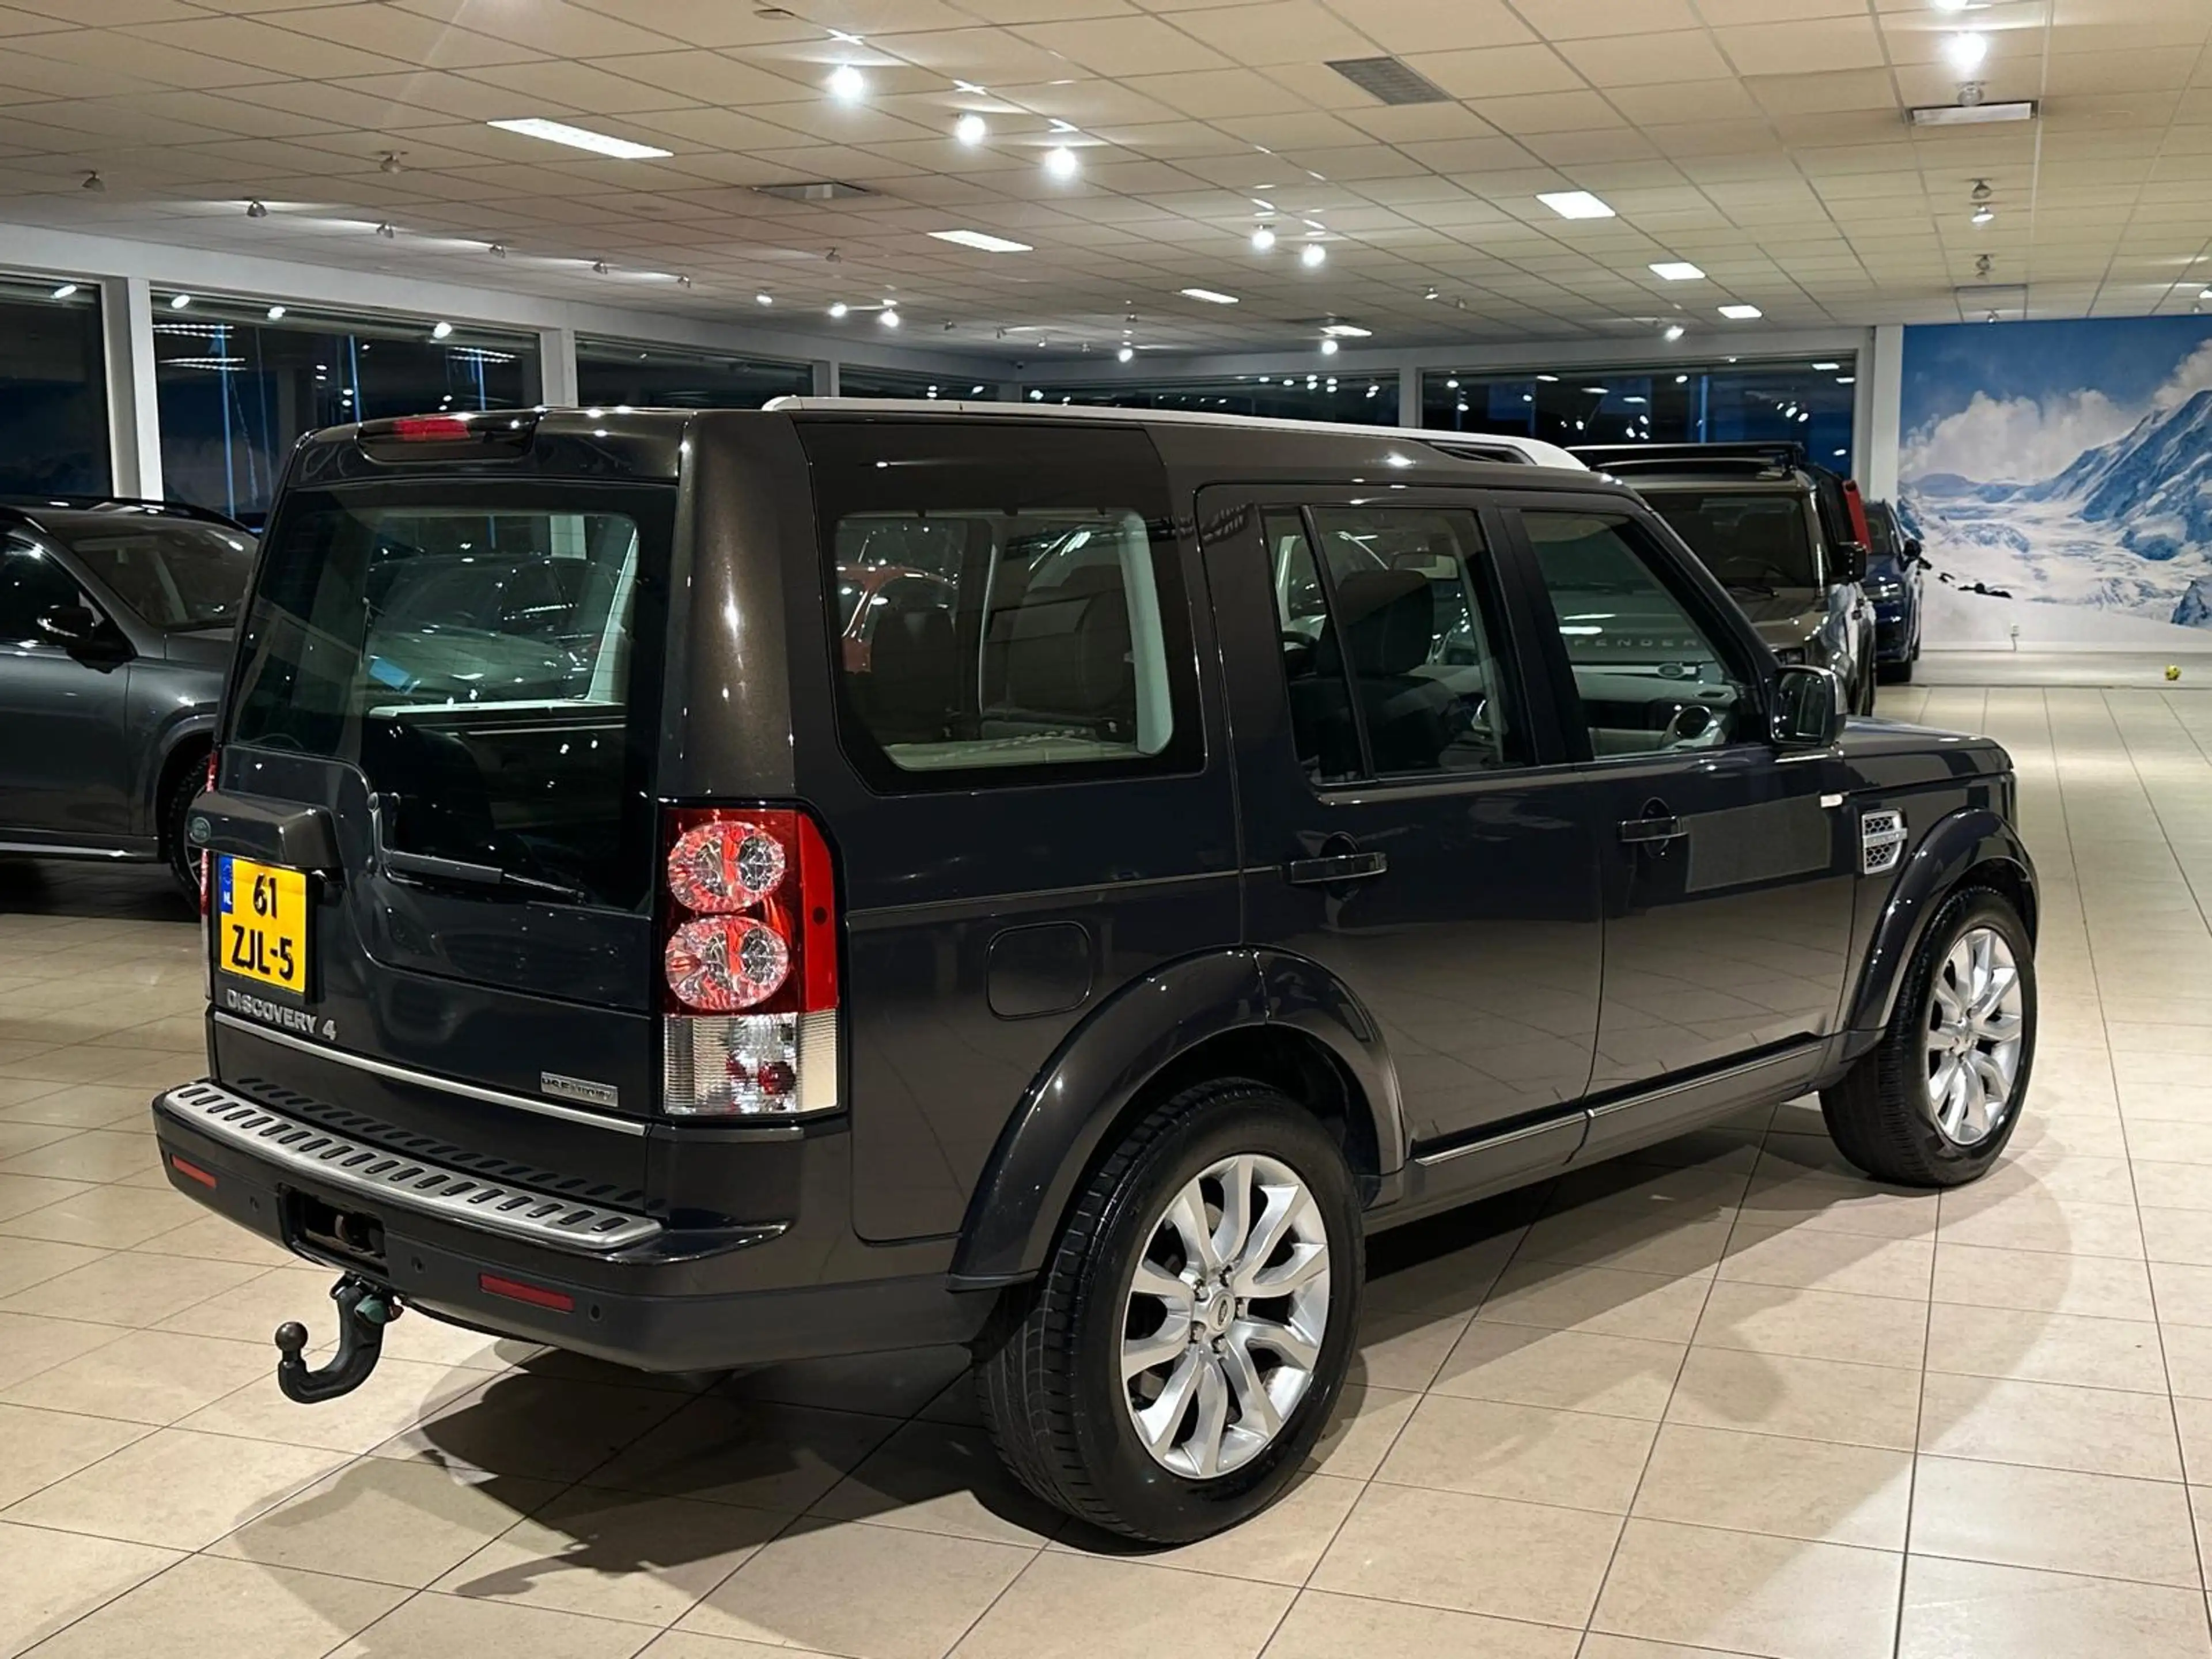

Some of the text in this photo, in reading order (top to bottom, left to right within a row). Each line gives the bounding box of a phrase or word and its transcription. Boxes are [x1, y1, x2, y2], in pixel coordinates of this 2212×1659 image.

[1574, 638, 1698, 646] FENDER
[253, 874, 277, 919] 61
[232, 924, 294, 981] ZJL-5
[226, 988, 336, 1040] DISCOVERY 4
